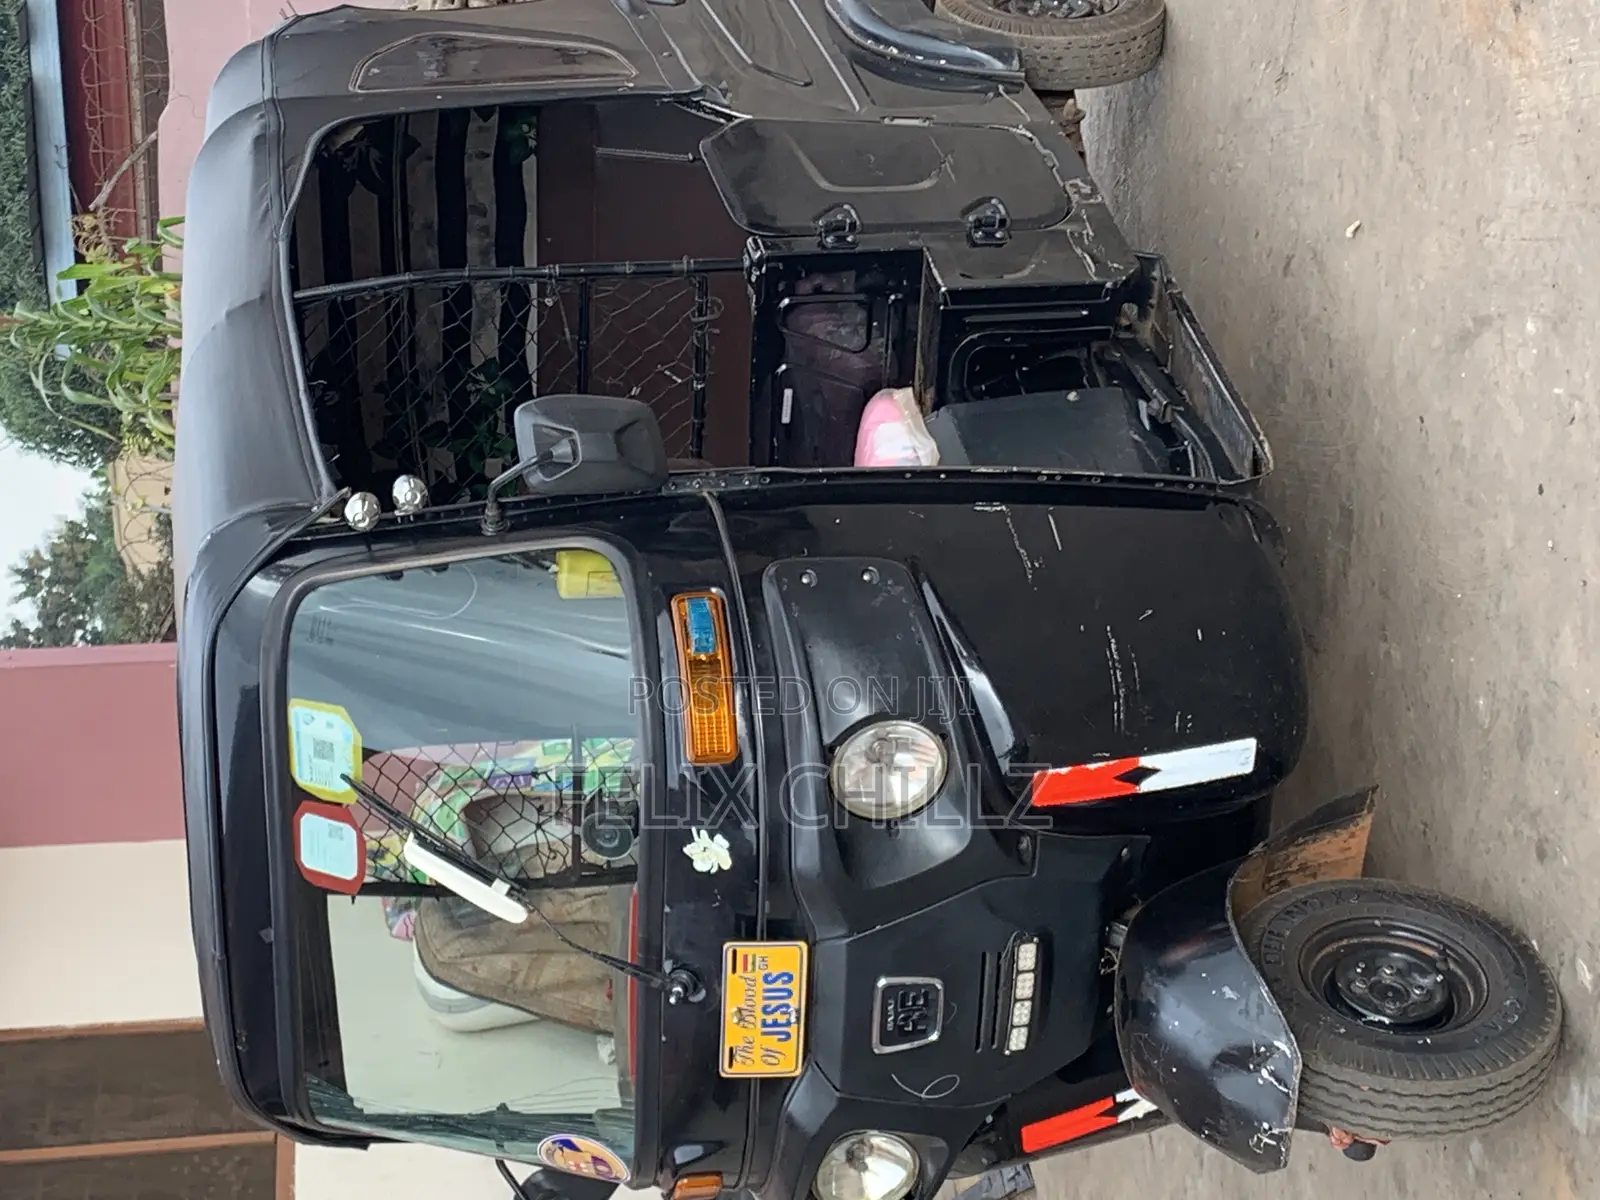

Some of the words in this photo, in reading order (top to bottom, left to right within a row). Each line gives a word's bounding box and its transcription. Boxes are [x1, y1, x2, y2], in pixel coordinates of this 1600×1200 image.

[758, 956, 769, 971] GH
[739, 975, 757, 1030] Blood
[761, 971, 794, 1042] JESUS
[734, 1035, 755, 1066] The
[760, 1044, 785, 1067] Of
